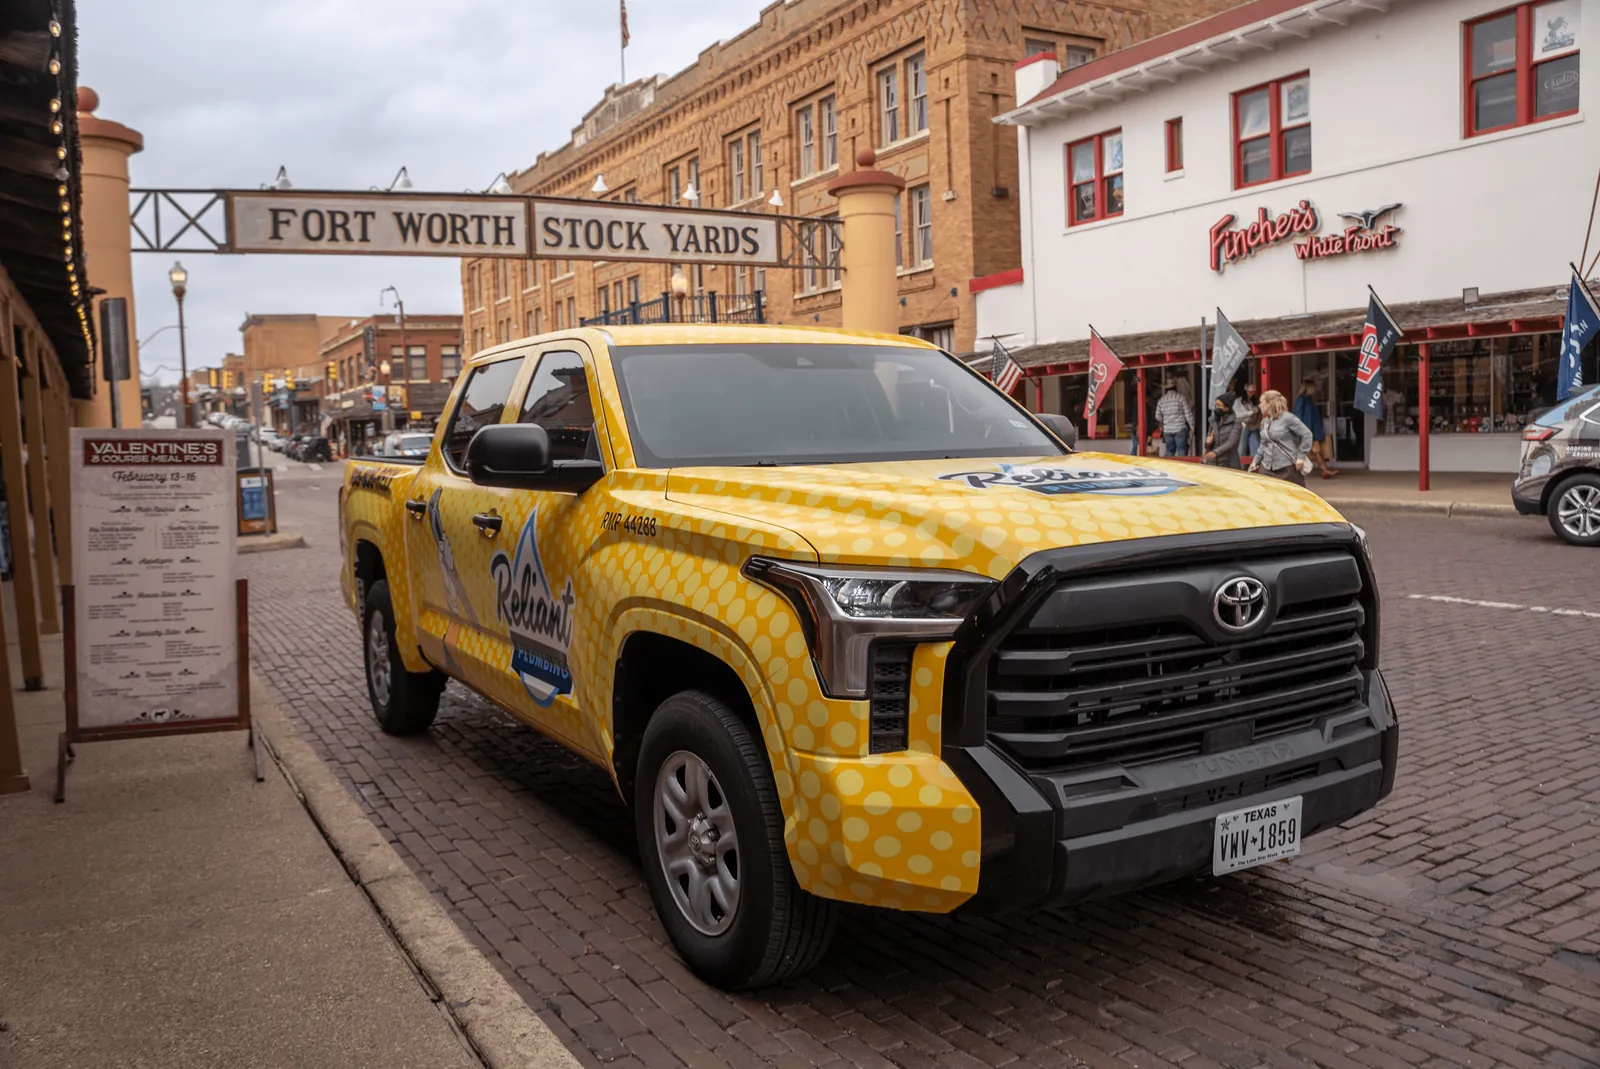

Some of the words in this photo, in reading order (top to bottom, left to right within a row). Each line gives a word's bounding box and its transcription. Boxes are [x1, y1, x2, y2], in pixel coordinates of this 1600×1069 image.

[268, 208, 376, 243] FORT
[393, 211, 516, 246] WORTH
[542, 216, 651, 253] STOCK
[663, 223, 760, 257] YARDS
[1209, 199, 1317, 271] Fincher's
[90, 442, 218, 454] VALENTINE'S
[101, 455, 149, 463] COURSE
[112, 470, 168, 484] February
[938, 468, 1169, 489] Reliant
[600, 511, 623, 531] RMP
[623, 514, 657, 537] 44288
[490, 553, 575, 642] Reliant
[517, 648, 570, 680] PLUMBING
[1180, 747, 1297, 779] TUNDRA
[1244, 805, 1277, 824] TEXAS
